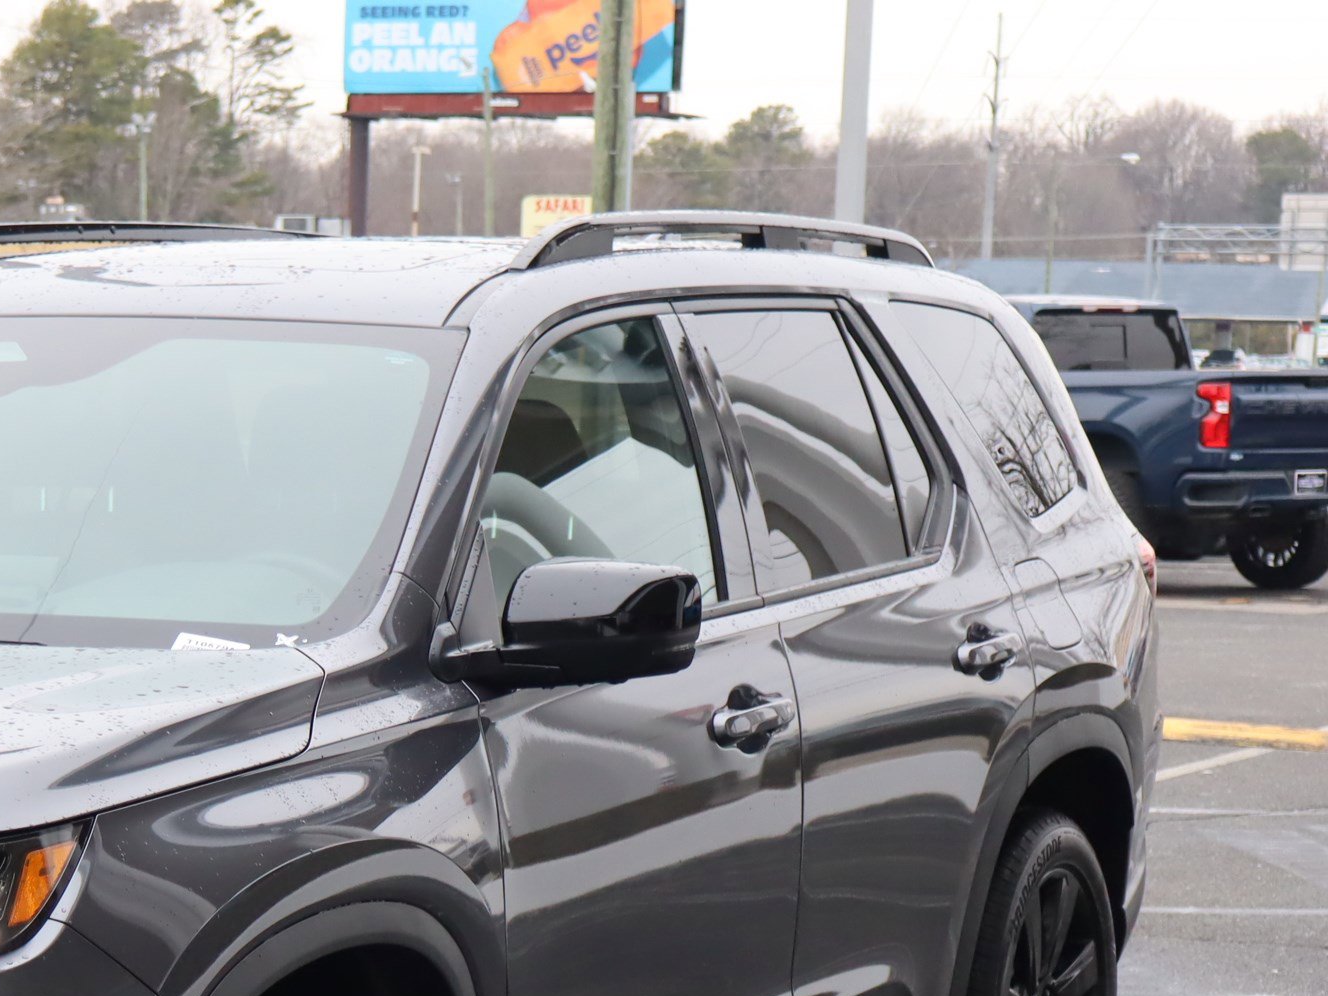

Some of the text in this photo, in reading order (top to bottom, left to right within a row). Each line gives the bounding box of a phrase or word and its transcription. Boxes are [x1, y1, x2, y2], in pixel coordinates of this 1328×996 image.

[360, 5, 469, 18] SEEING RED?
[352, 21, 477, 46] PEEL AN
[349, 47, 478, 78] ORANGE
